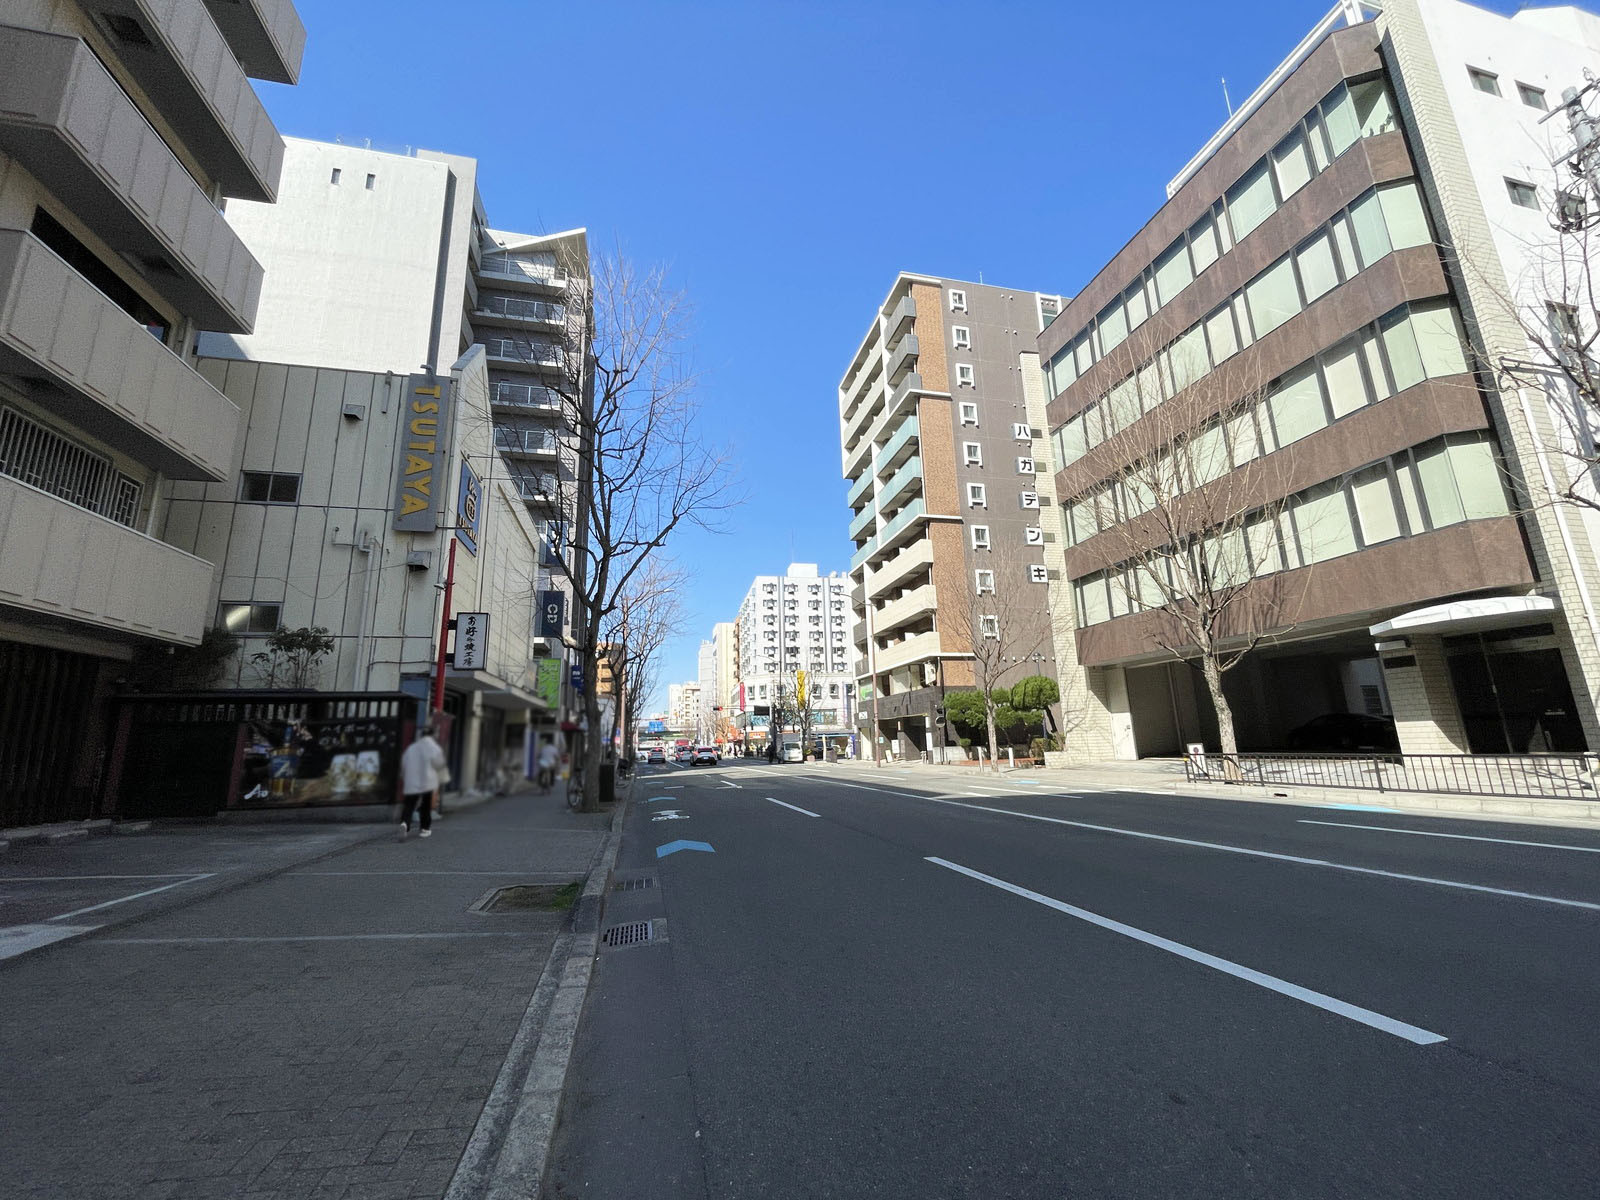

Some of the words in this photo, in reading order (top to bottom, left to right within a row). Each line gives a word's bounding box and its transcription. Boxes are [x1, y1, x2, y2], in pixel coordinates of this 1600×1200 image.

[401, 385, 442, 516] TSUTAYA
[1017, 425, 1046, 579] ハガデンキ
